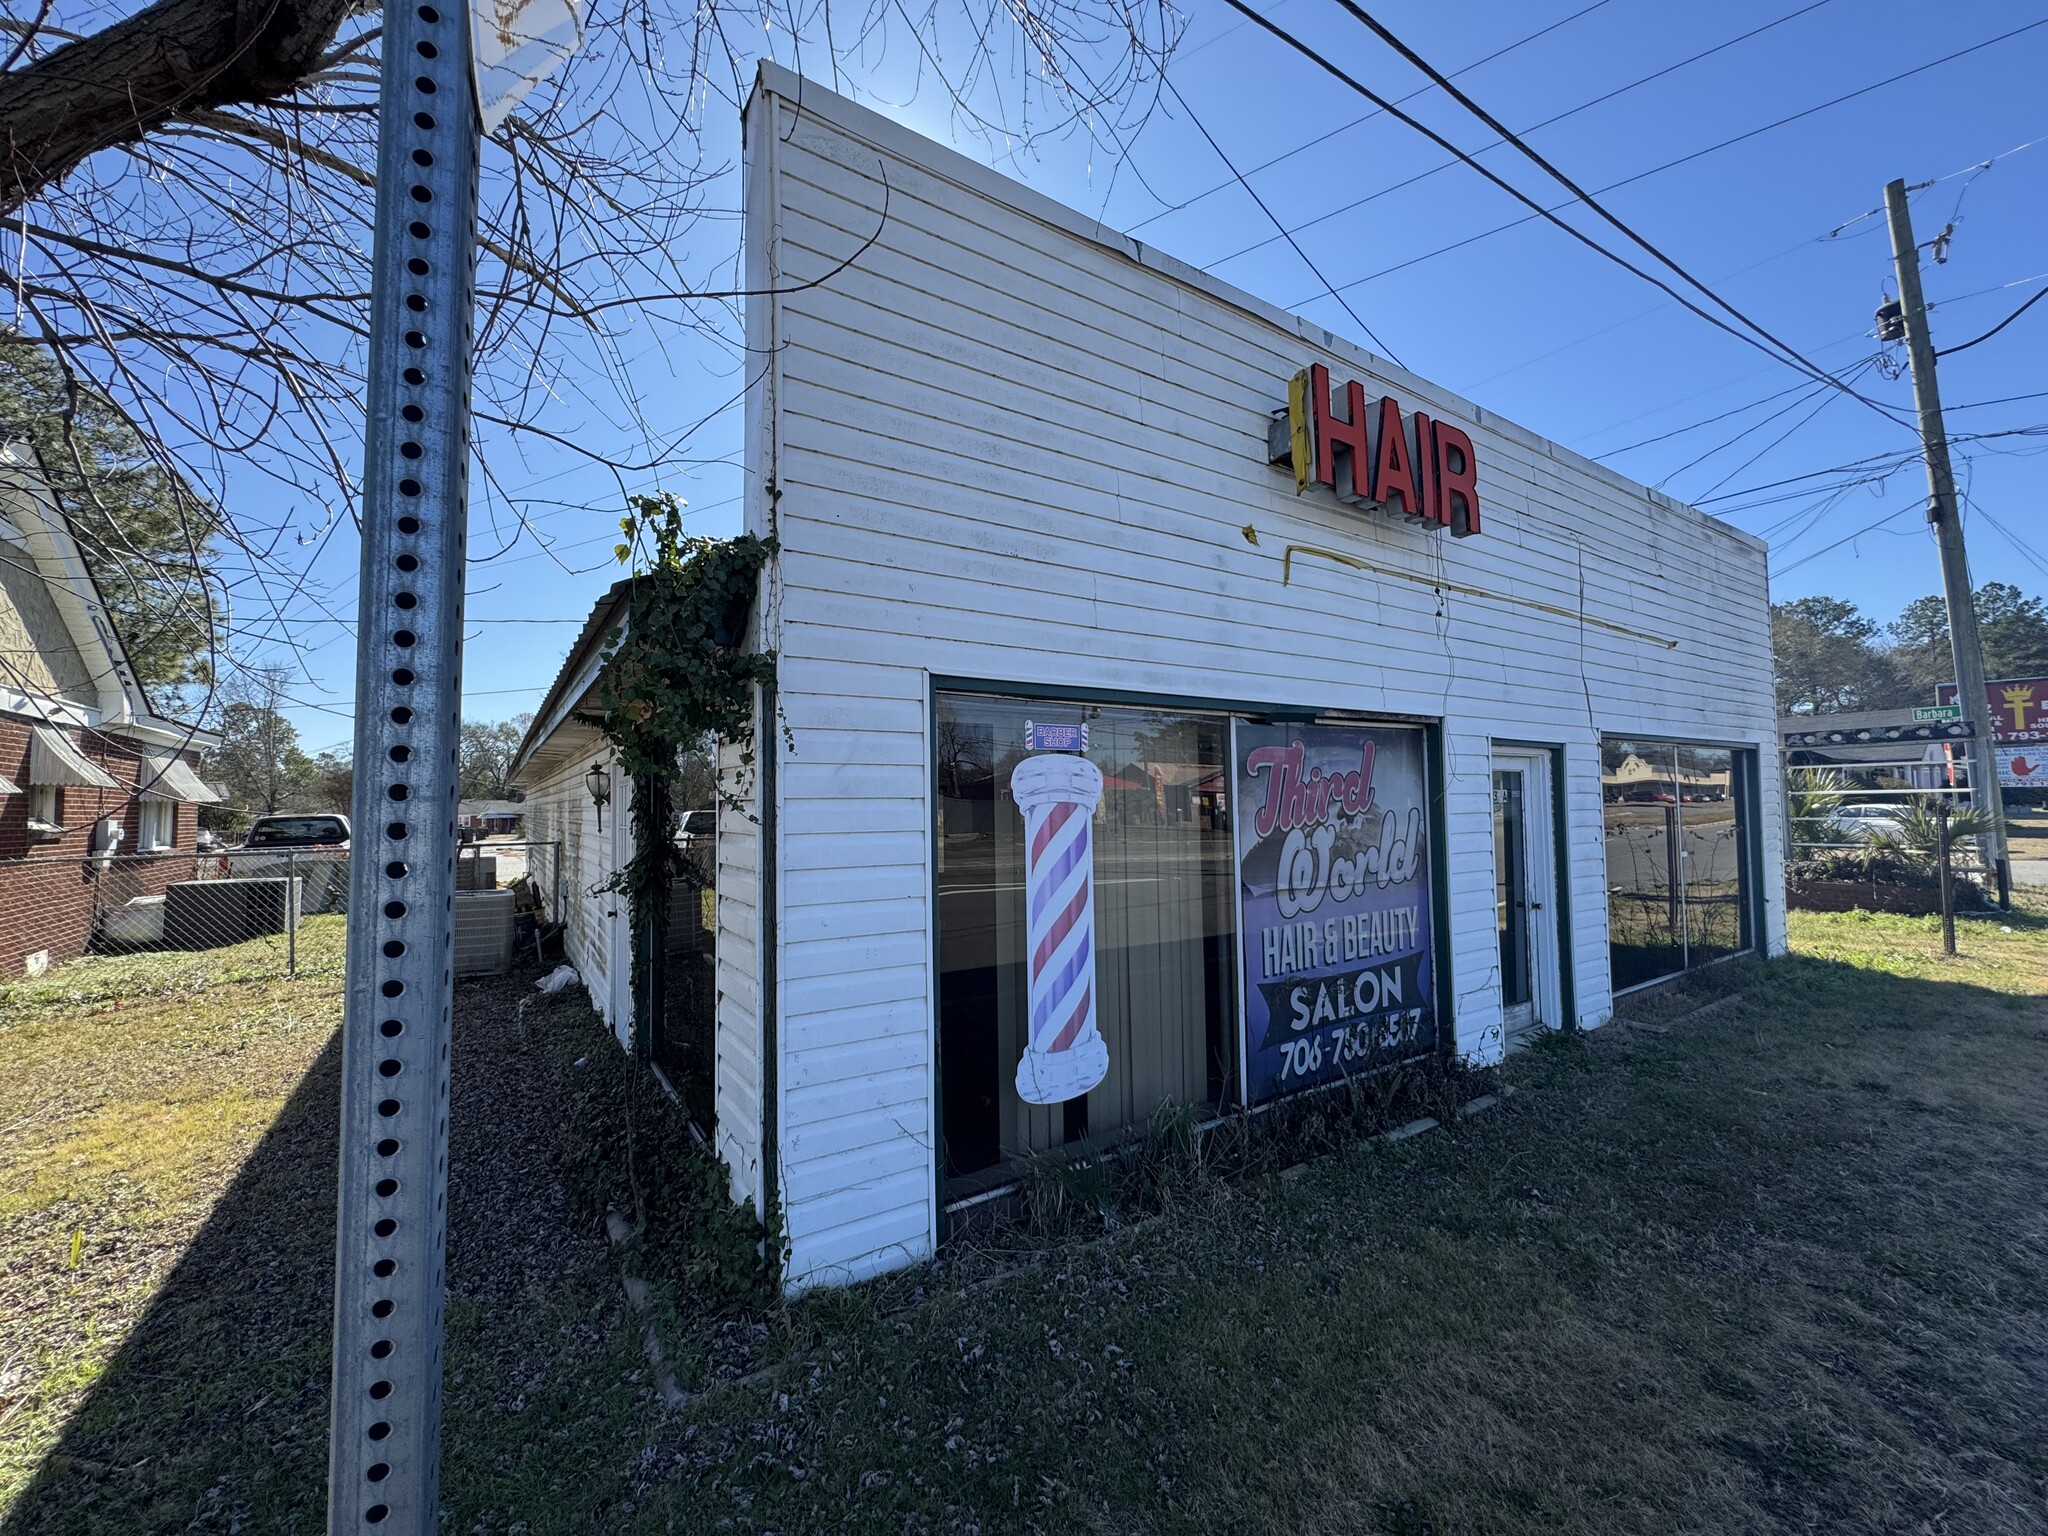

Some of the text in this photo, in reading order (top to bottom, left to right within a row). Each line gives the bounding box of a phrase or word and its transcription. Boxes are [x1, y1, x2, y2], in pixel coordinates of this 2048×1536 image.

[1311, 363, 1481, 537] HAIR
[1037, 727, 1077, 738] BARBER
[1044, 737, 1071, 747] SHOP
[1916, 709, 1953, 719] Barbara
[2007, 731, 2048, 741] 793-
[1247, 739, 1376, 838] Third
[1276, 808, 1420, 918] World
[1262, 905, 1419, 979] HAIR & BEAUTY
[1290, 964, 1403, 1031] SALON
